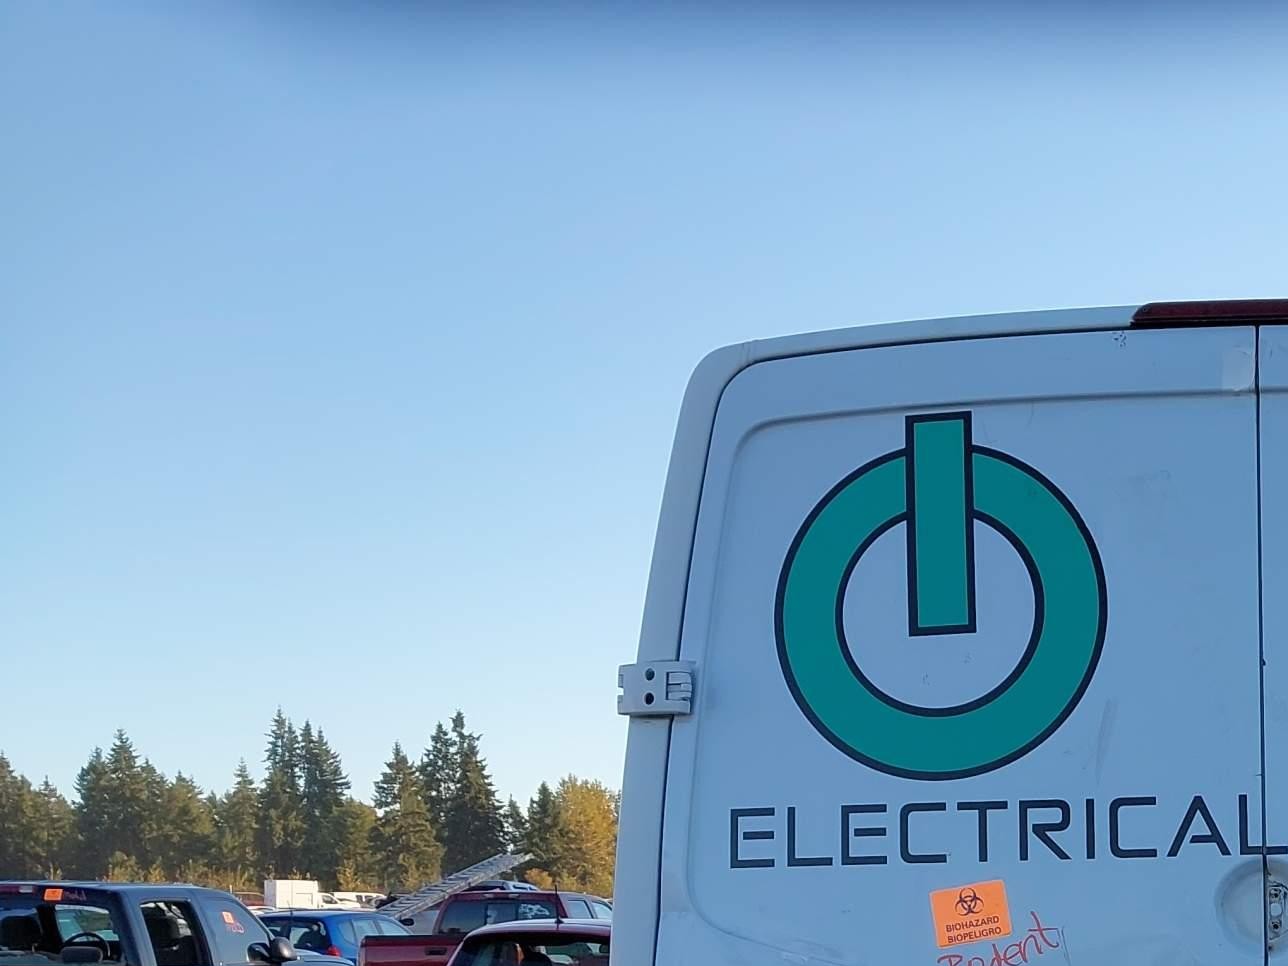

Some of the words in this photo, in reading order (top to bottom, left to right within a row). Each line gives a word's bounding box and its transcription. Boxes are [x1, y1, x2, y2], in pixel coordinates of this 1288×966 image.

[729, 793, 1288, 869] ELECTRICAL
[945, 915, 1000, 933] BIOHAZARD
[946, 926, 1002, 944] BIOPELIGRO
